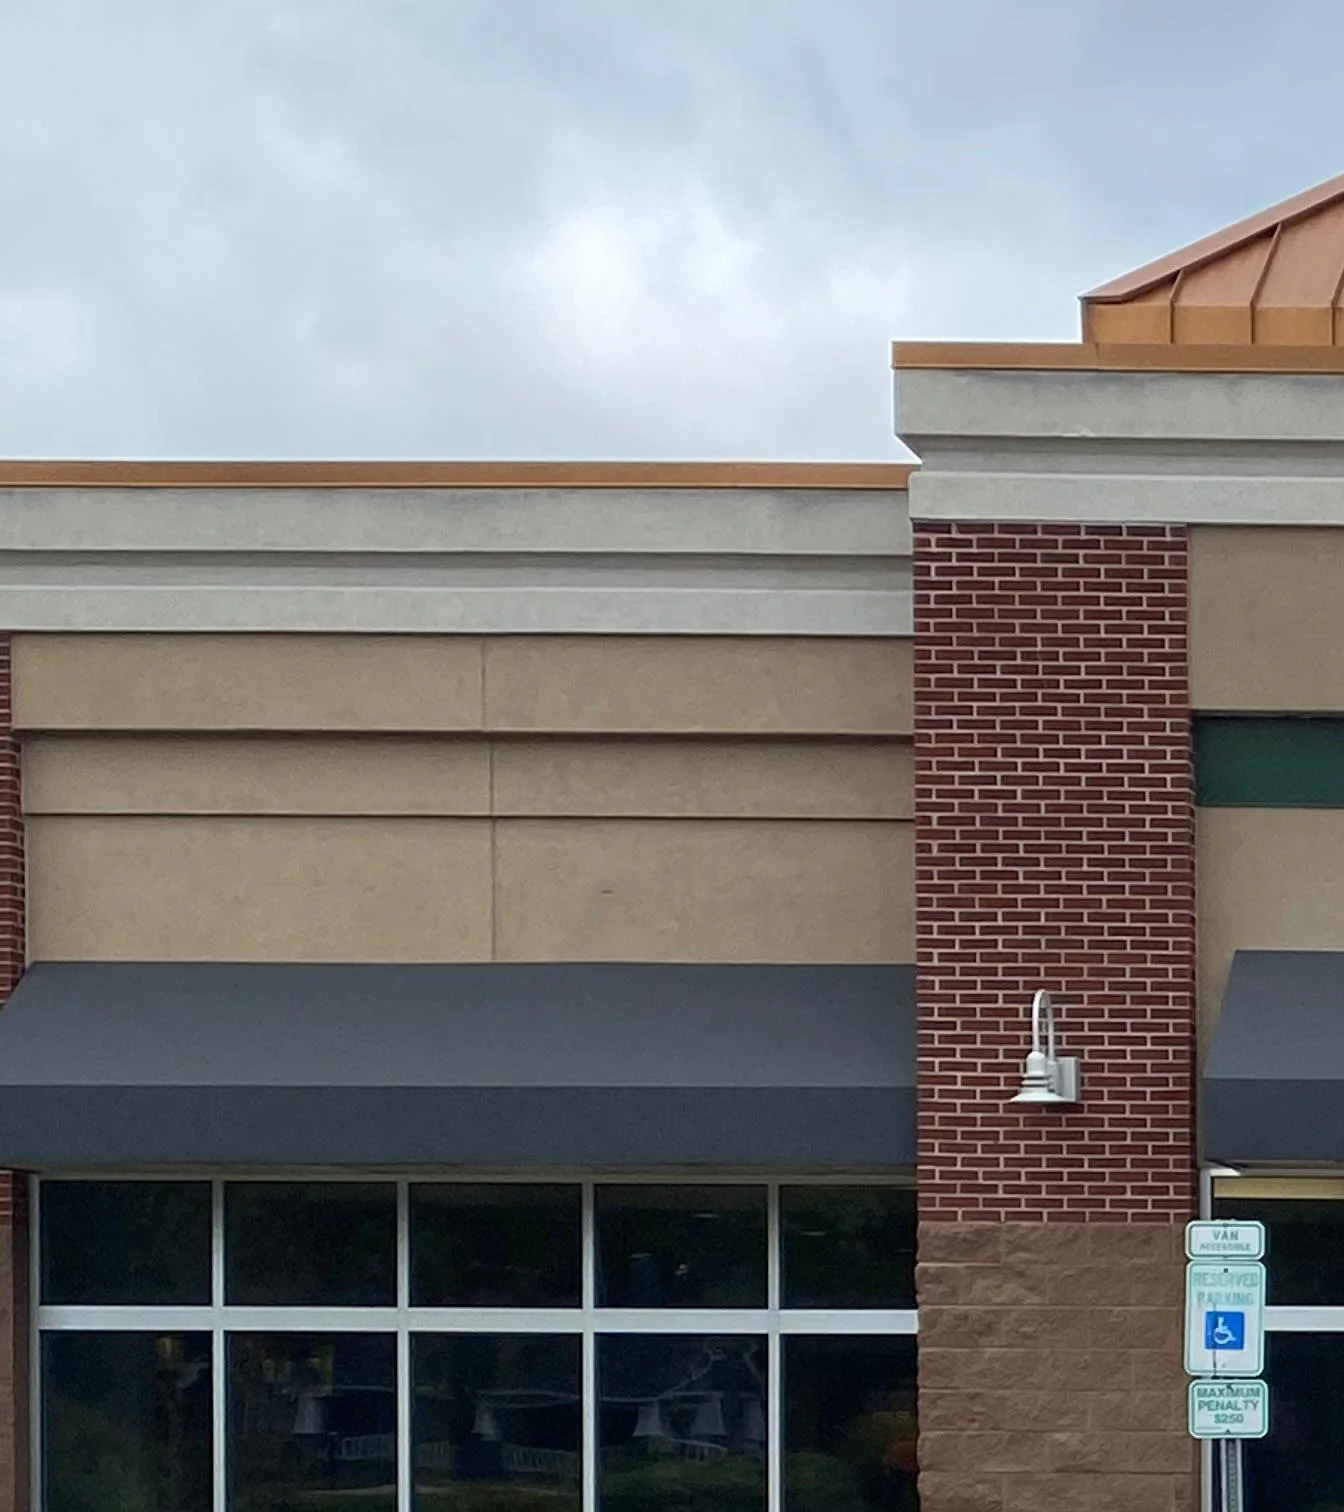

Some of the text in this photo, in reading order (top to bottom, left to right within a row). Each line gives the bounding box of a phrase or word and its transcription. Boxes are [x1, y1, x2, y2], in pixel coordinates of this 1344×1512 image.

[1212, 1229, 1239, 1241] VAN
[1199, 1242, 1252, 1251] ACCESSIBLE
[1193, 1272, 1259, 1287] RESERVED
[1196, 1292, 1254, 1305] PARKING
[1196, 1387, 1261, 1398] MAXIMUM
[1198, 1400, 1260, 1411] PENALTY
[1213, 1413, 1244, 1424] $250
